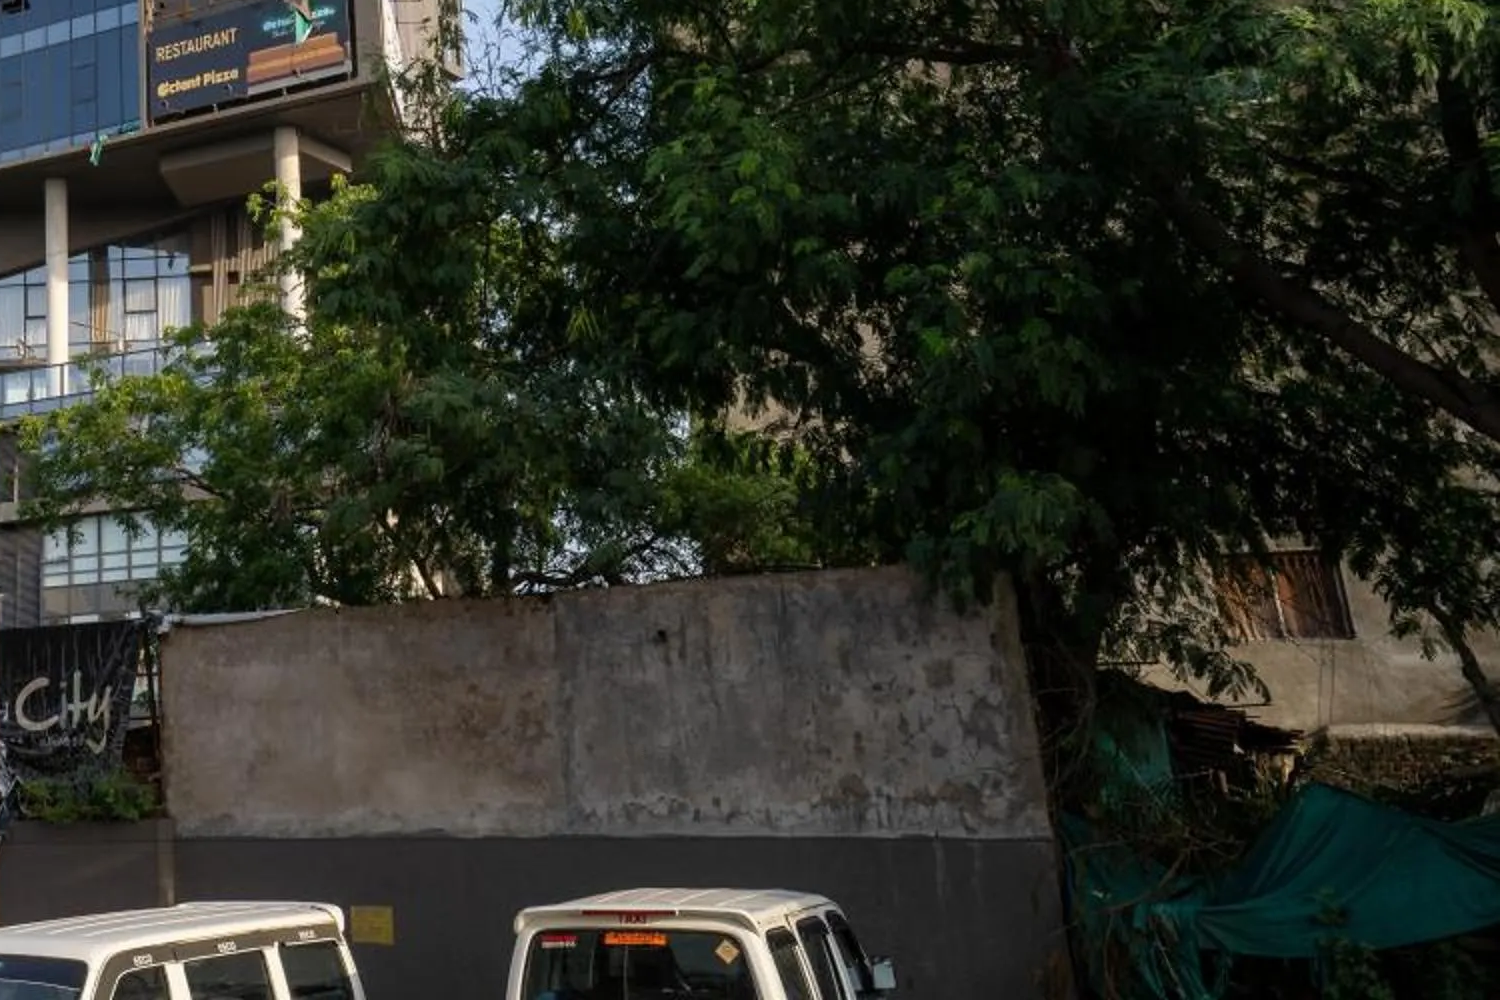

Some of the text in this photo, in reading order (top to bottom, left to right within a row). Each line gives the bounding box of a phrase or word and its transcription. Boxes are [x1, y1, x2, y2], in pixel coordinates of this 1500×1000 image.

[156, 28, 239, 63] RESTAURANT
[203, 68, 239, 87] Pizza
[15, 669, 113, 755] City
